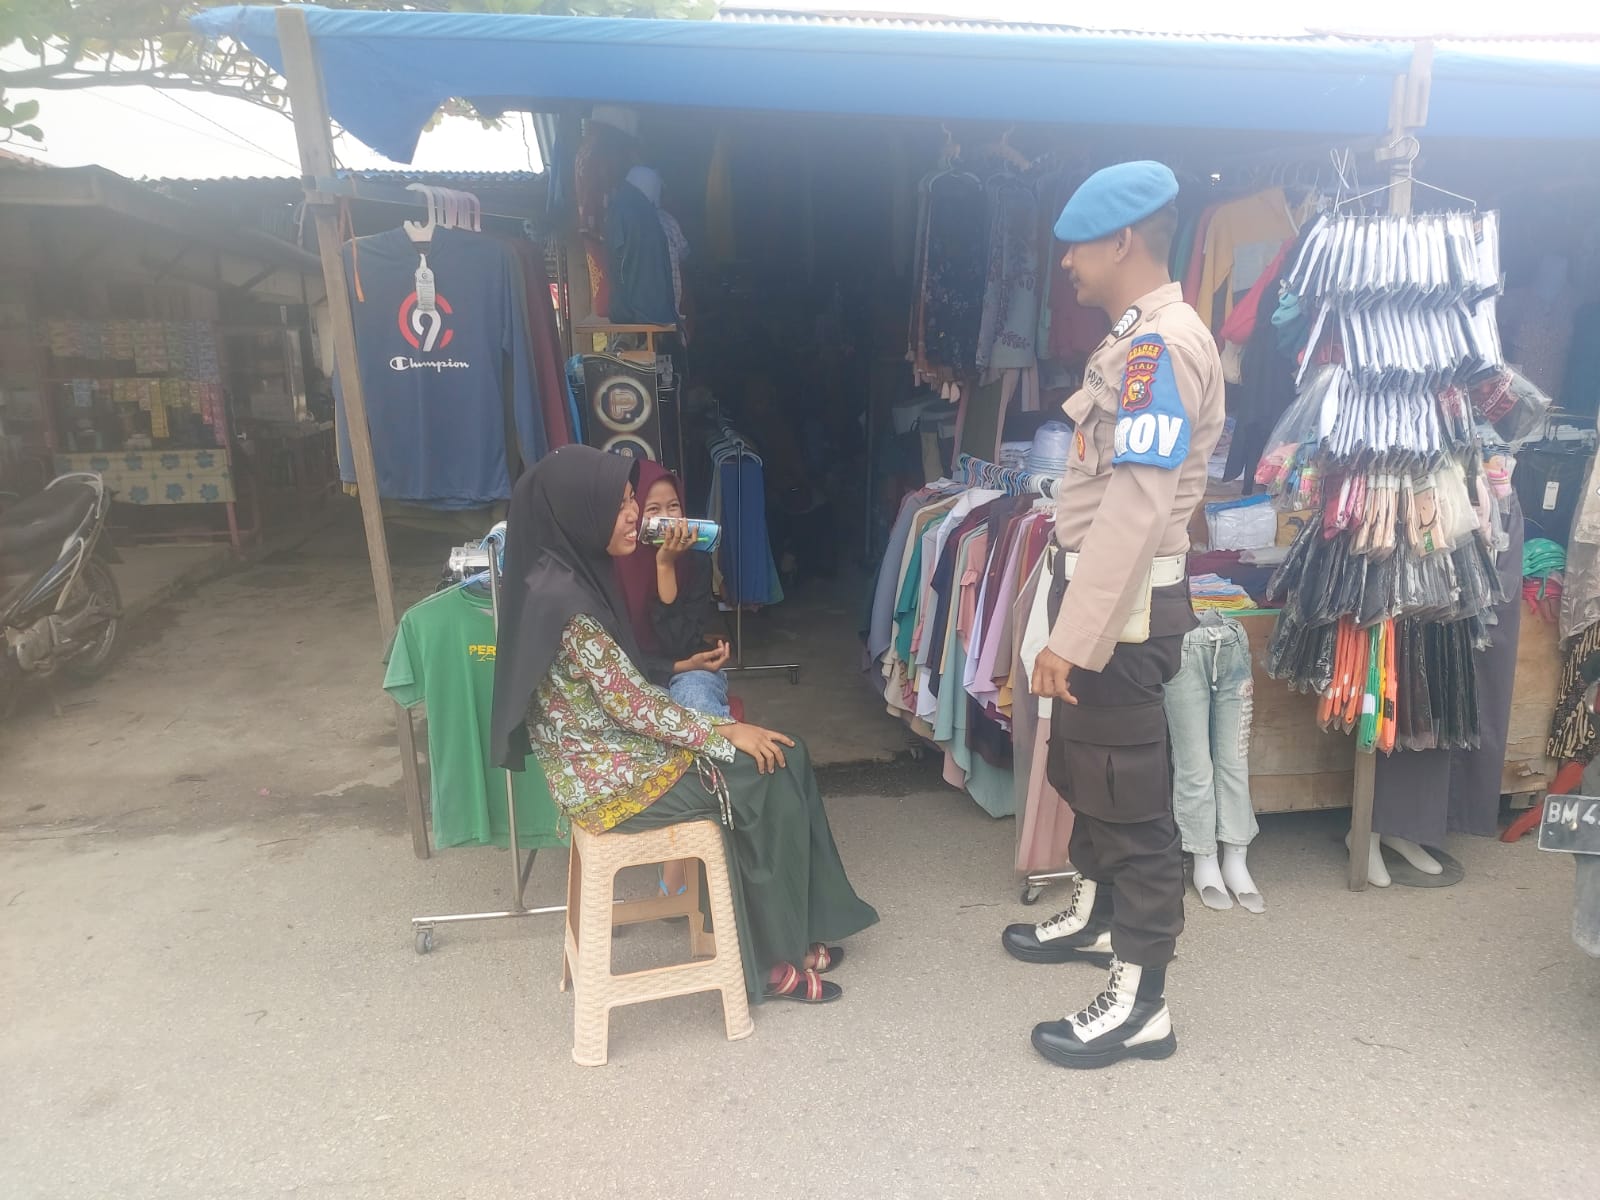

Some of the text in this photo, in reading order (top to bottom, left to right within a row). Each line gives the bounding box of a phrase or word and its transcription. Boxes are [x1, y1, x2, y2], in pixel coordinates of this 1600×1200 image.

[389, 356, 470, 373] Champion
[1128, 362, 1155, 372] RIAU
[1546, 801, 1600, 825] BM 4
